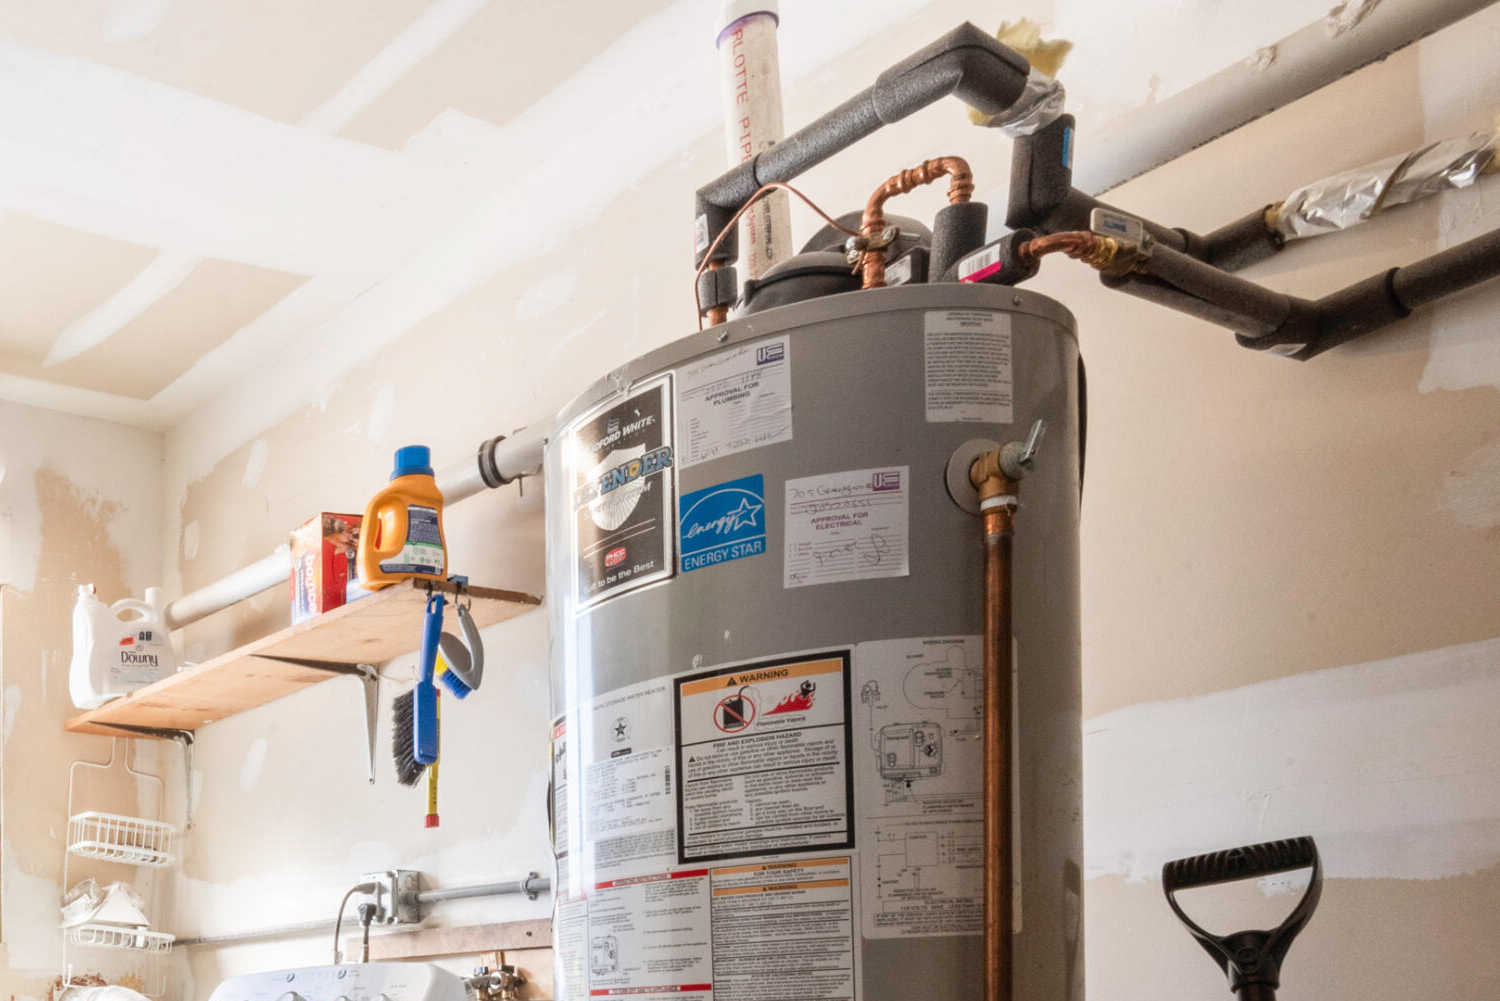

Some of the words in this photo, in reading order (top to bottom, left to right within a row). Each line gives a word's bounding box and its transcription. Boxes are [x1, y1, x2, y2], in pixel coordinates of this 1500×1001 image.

[704, 386, 742, 402] APPROVAL
[744, 381, 760, 391] FOR
[713, 392, 751, 406] PLUMBING
[622, 414, 654, 437] WHITE
[811, 512, 851, 525] APPROVAL
[853, 511, 869, 520] FOR
[815, 519, 863, 531] ELECTRICAL
[684, 549, 730, 571] ENERGY
[731, 540, 763, 559] STAR
[607, 574, 617, 584] be
[618, 569, 632, 580] the
[633, 560, 655, 575] Best
[121, 650, 158, 668] Downy
[739, 668, 789, 684] WARNING
